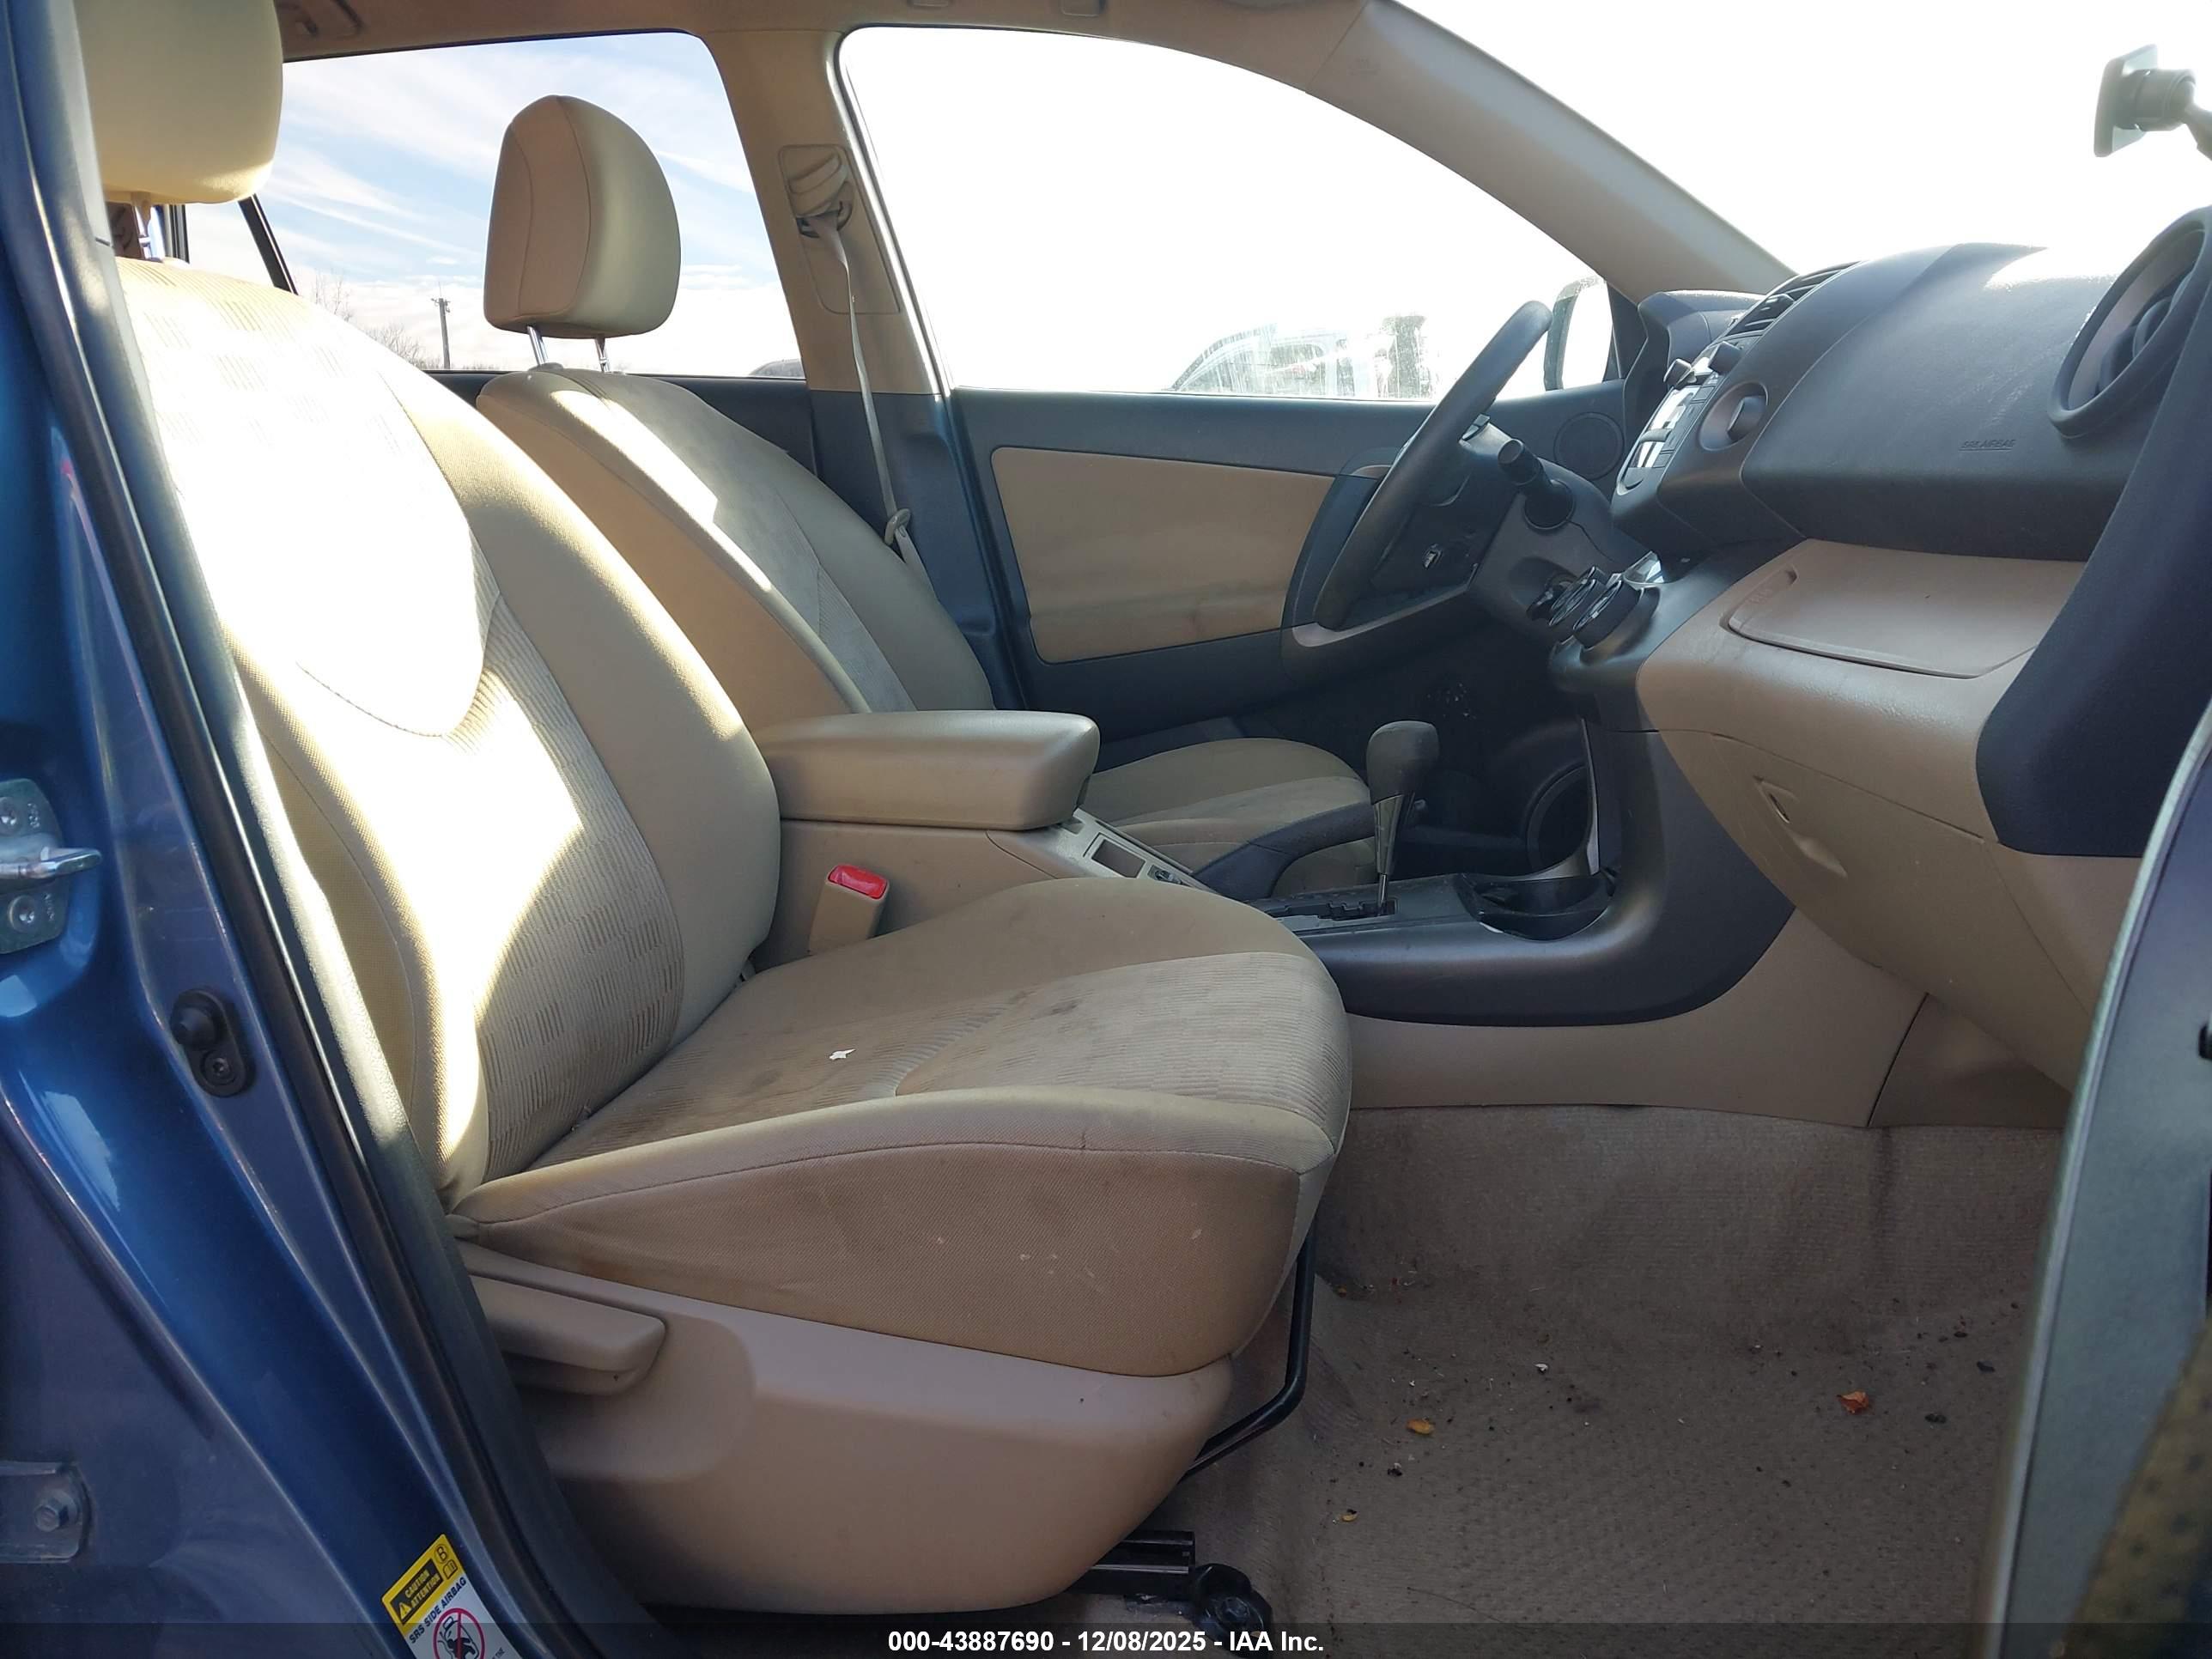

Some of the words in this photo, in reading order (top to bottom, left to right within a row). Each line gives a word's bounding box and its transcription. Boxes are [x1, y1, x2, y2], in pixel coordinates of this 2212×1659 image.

[404, 1569, 430, 1599] CAUTION
[410, 1574, 441, 1607] ATTENTION
[409, 1626, 425, 1644] SRS
[424, 1606, 441, 1628] SIDE
[441, 1577, 467, 1608] AIRBAG
